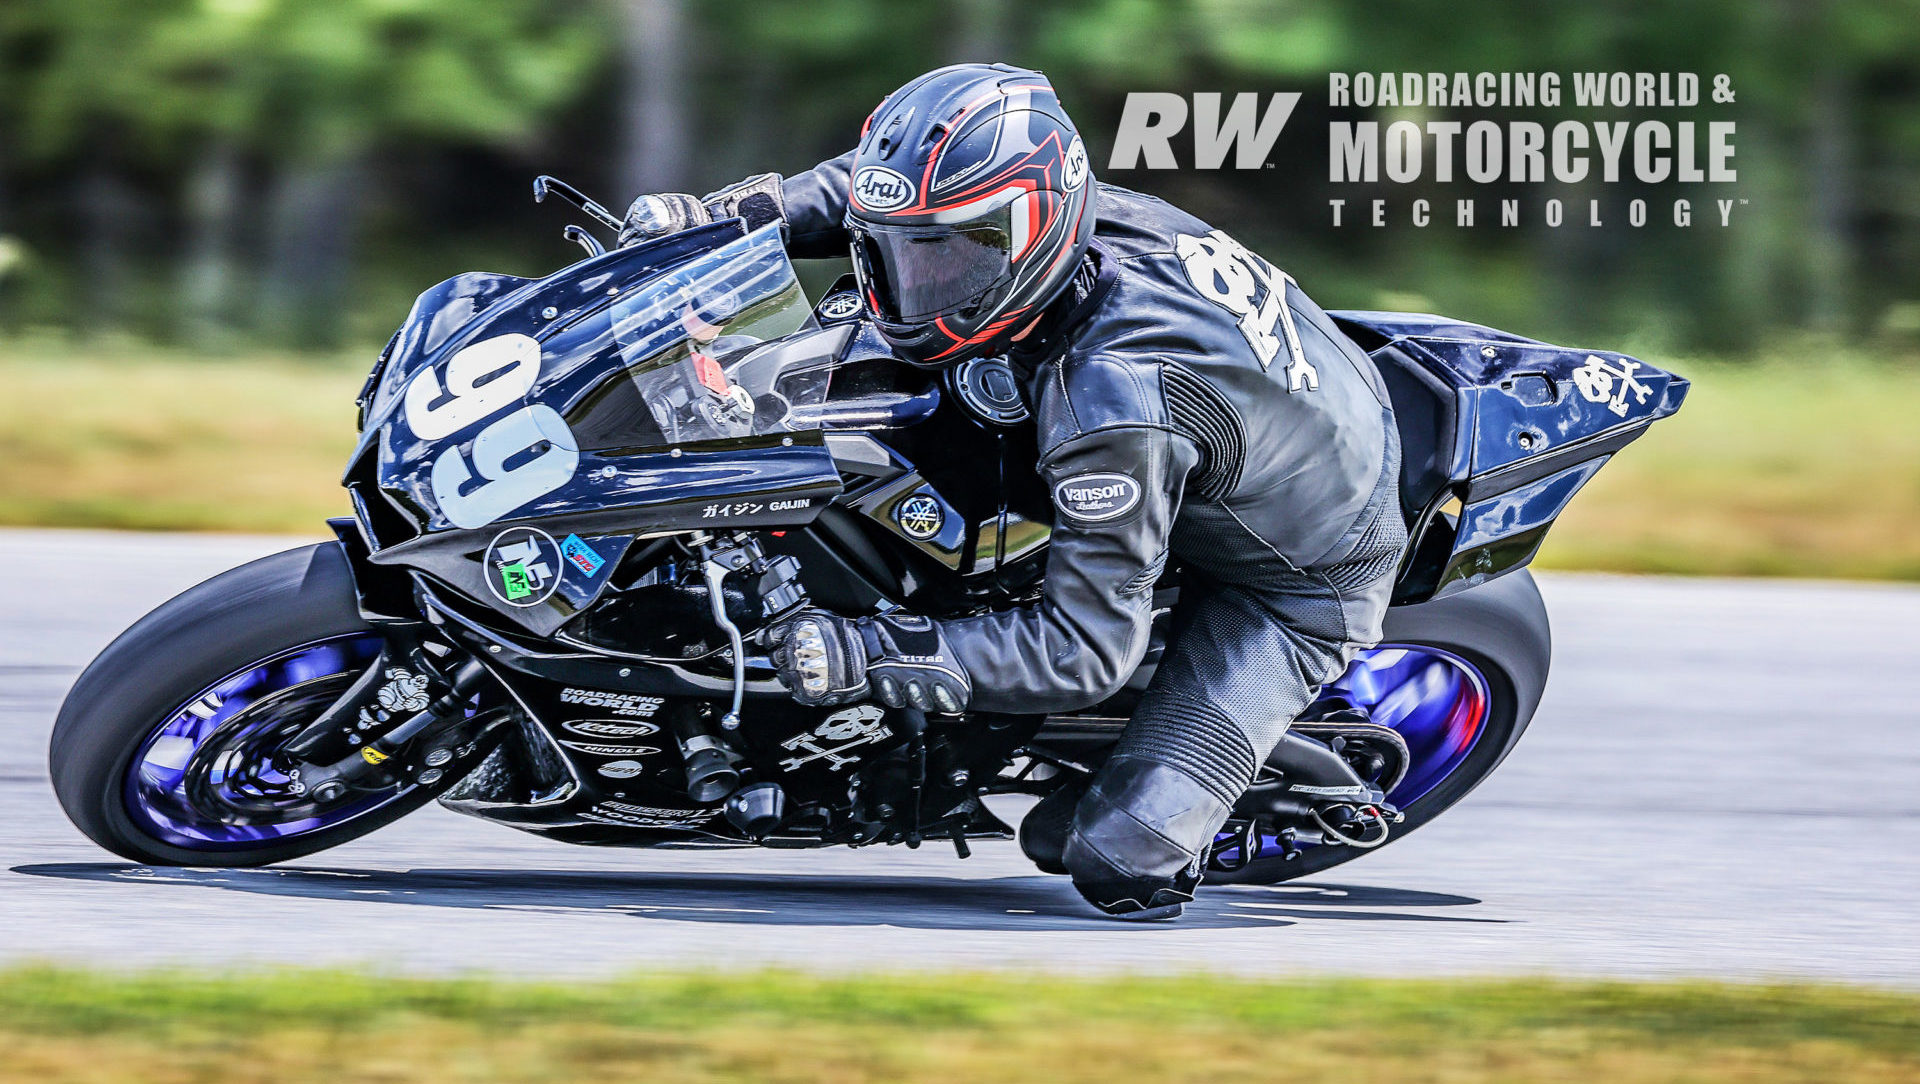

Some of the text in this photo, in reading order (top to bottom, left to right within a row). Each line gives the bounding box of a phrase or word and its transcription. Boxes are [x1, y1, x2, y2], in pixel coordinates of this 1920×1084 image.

[857, 172, 903, 200] Arai
[702, 499, 811, 518] ガイジン GAIJIN
[560, 694, 660, 711] WORLD
[561, 687, 665, 704] ROADRACING
